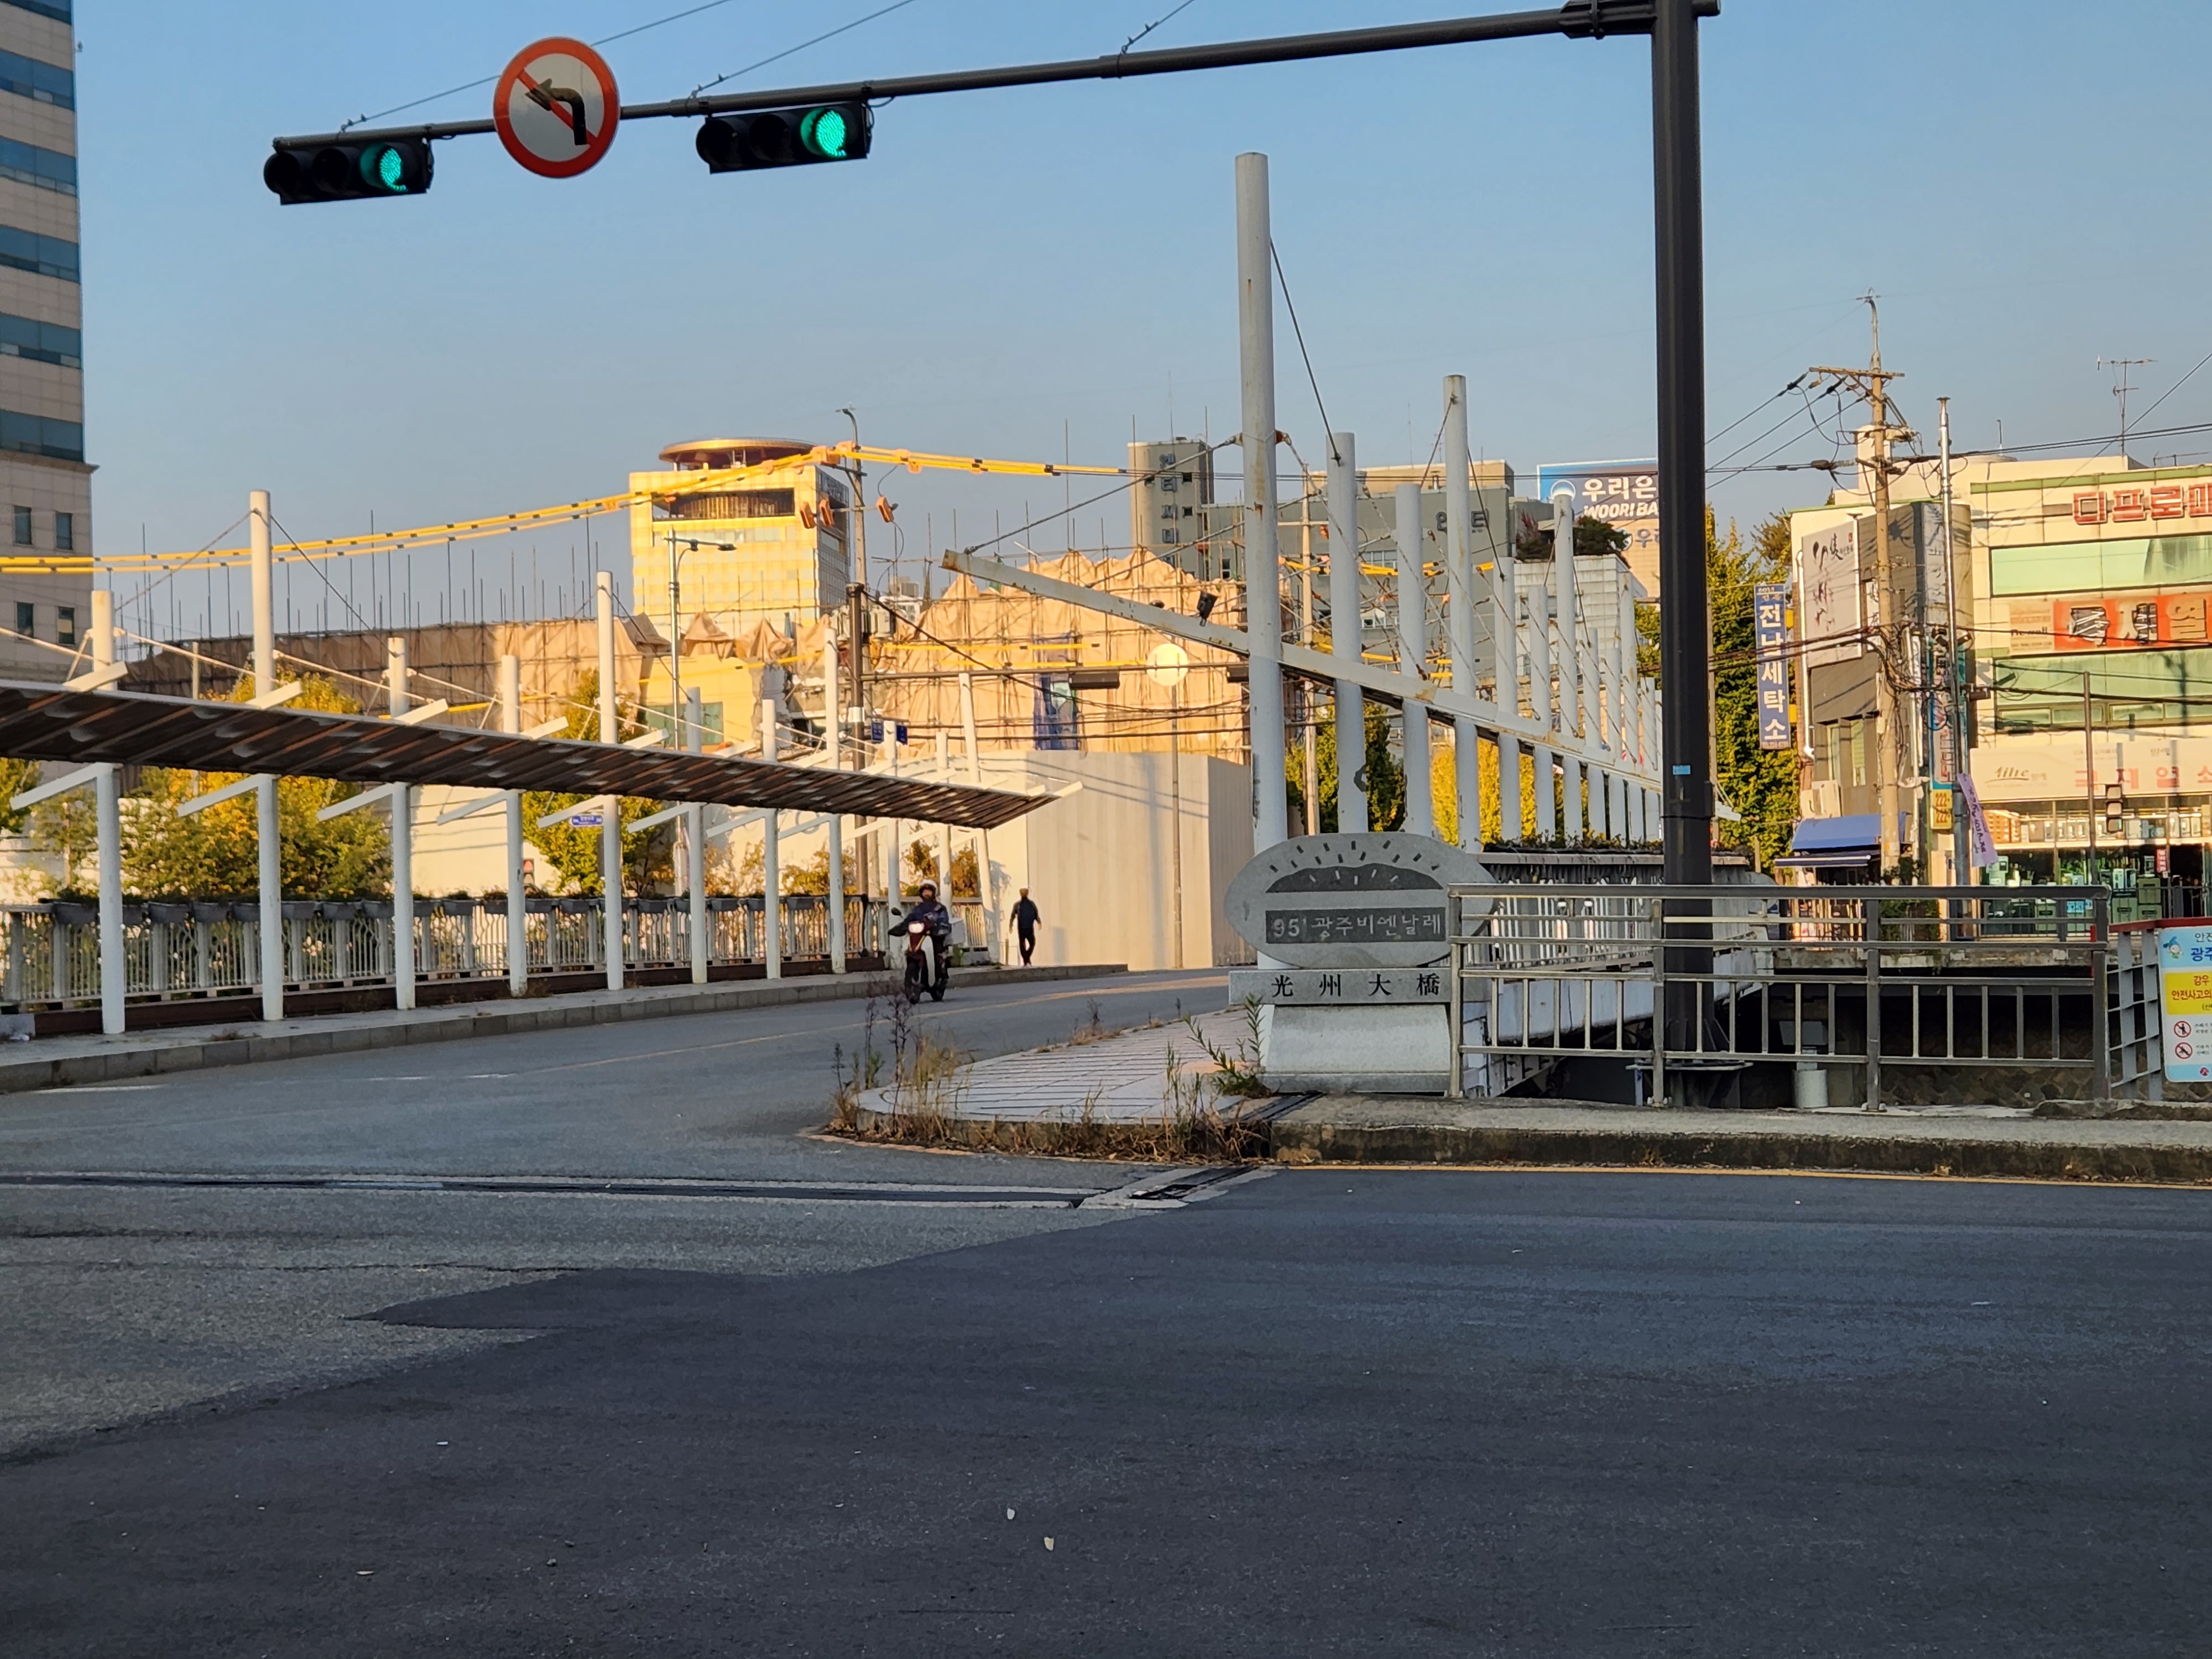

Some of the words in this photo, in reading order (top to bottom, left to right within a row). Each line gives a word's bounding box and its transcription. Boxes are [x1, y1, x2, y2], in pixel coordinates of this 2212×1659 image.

[1311, 914, 1441, 938] 광주비엔날레
[1272, 973, 1441, 997] 光州大橋
